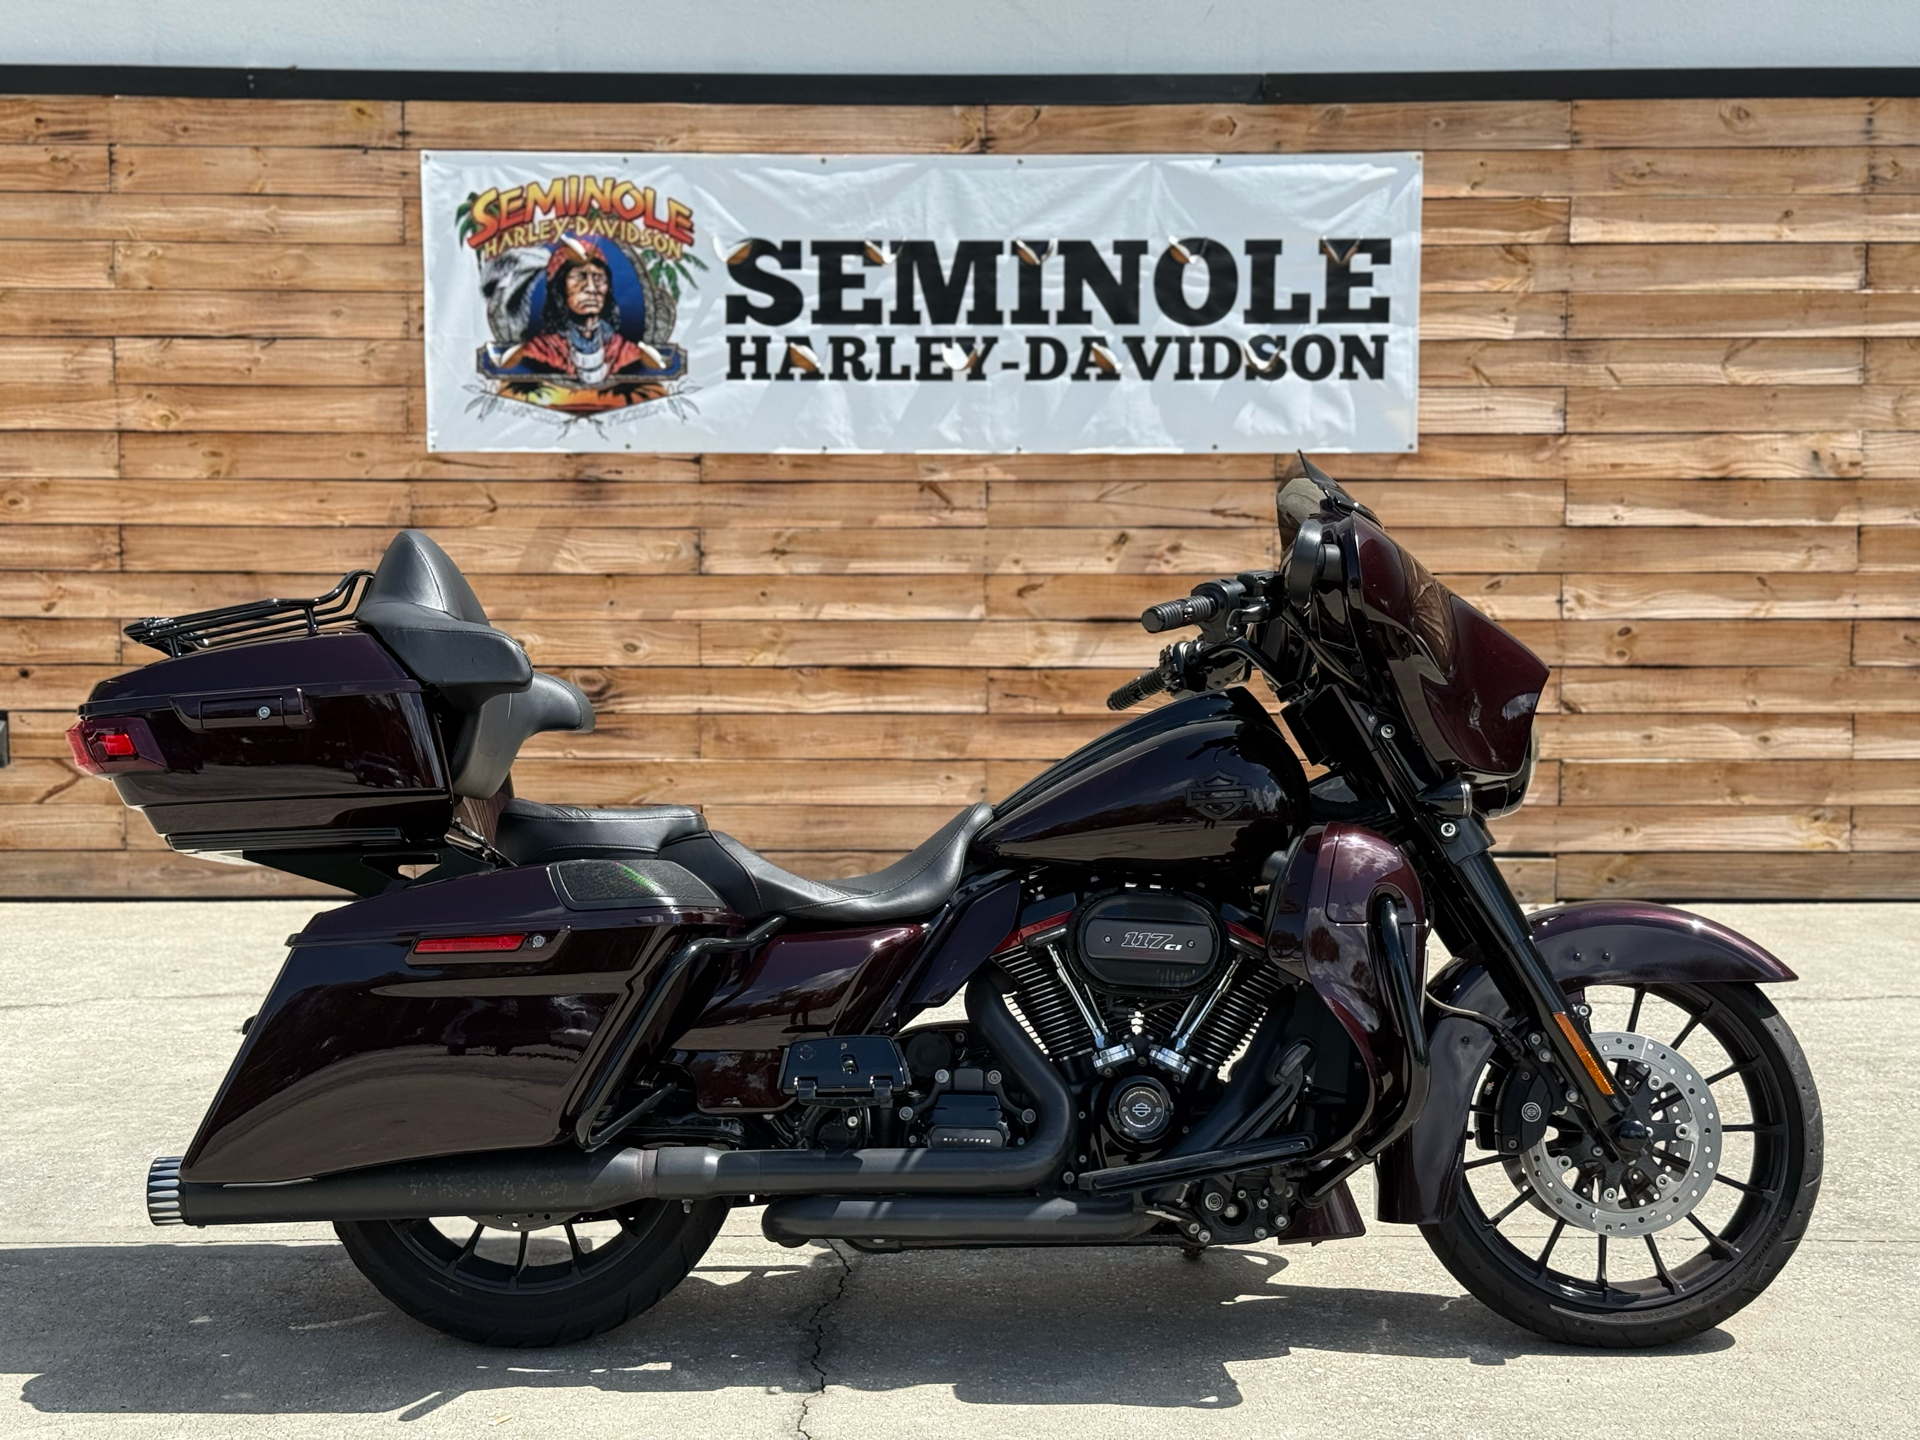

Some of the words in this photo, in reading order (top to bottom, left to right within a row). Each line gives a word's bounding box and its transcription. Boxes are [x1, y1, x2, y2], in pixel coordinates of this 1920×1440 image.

[467, 175, 695, 246] SEMINOLE
[483, 216, 683, 261] HARLEY-DAVIDSON
[726, 236, 1391, 326] SEMINOLE
[726, 334, 1389, 382] HARLEY-DAVIDSON
[1121, 931, 1173, 949] 117
